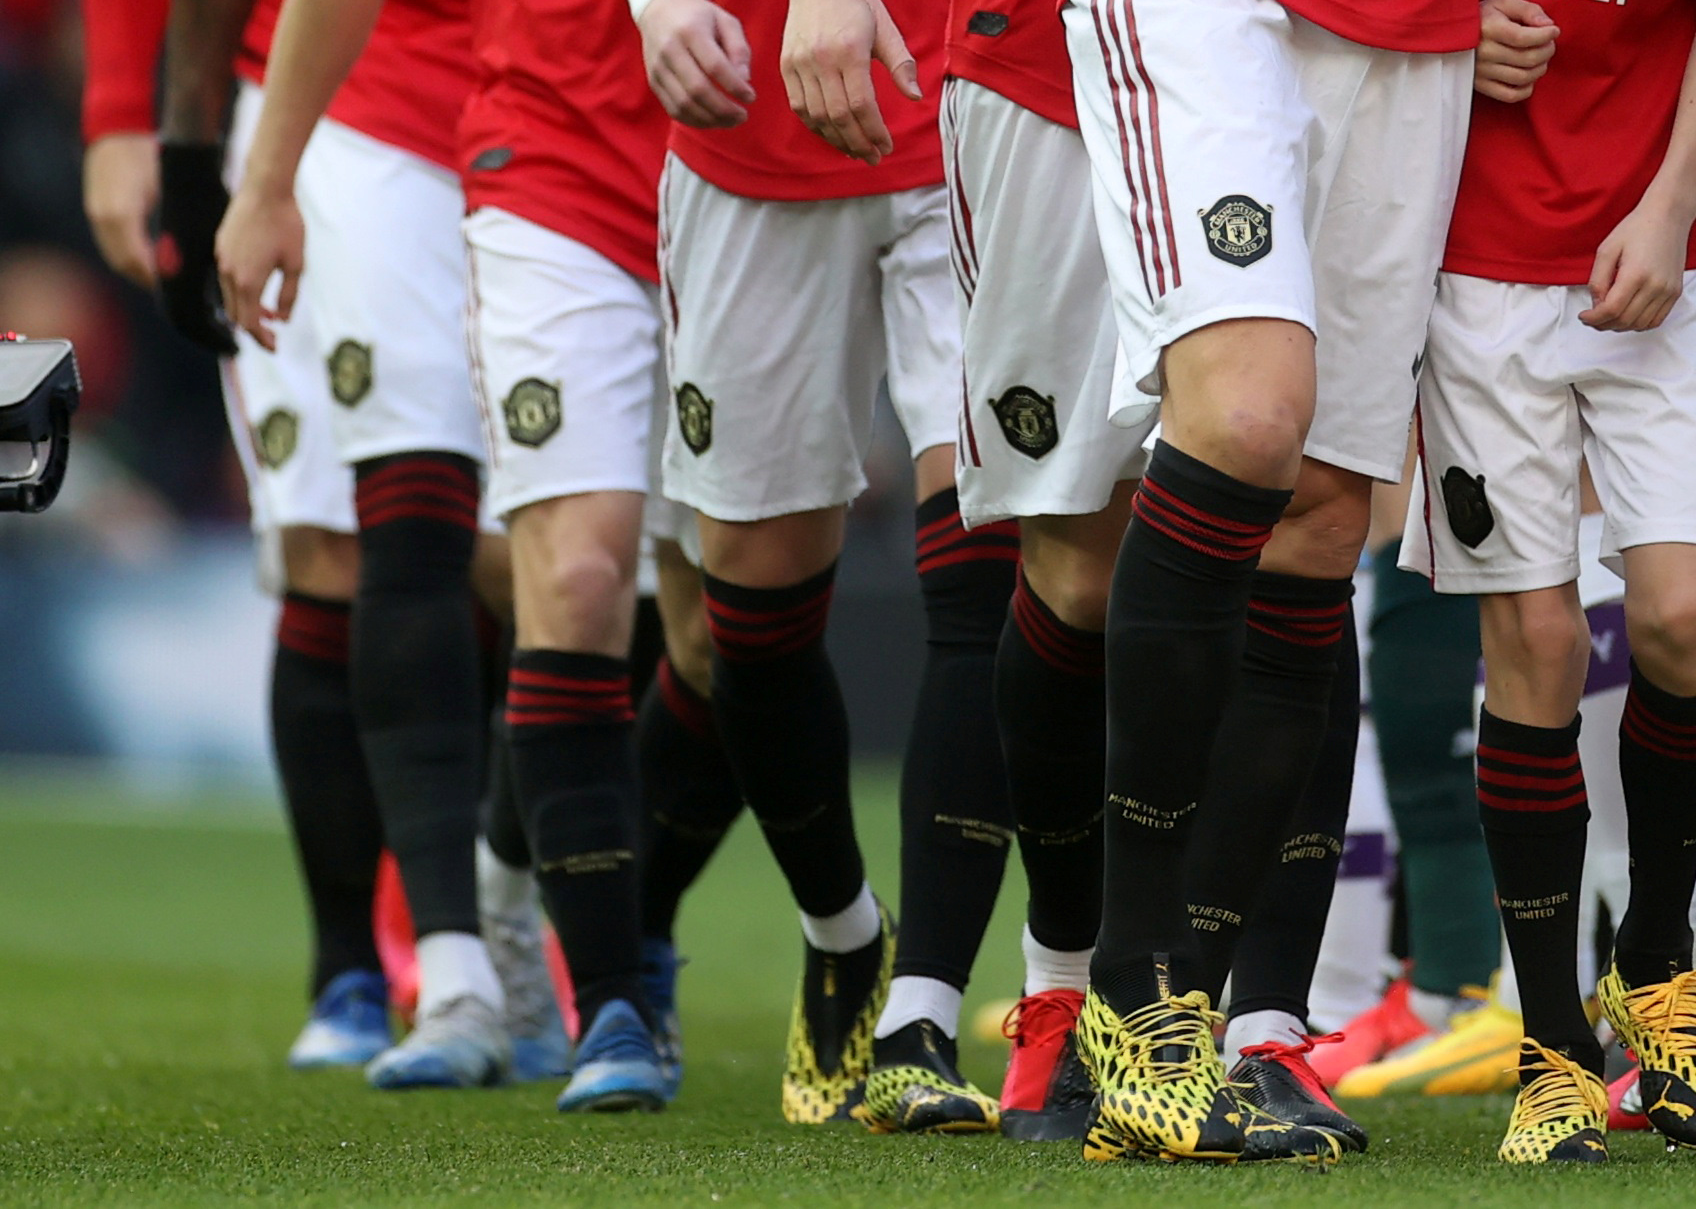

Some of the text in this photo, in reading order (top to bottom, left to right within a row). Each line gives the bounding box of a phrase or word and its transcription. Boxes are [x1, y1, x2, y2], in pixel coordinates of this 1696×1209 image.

[1122, 809, 1174, 829] UNITED
[1281, 847, 1326, 864] UNITED
[1500, 892, 1569, 910] MANCHESTER
[1515, 907, 1555, 920] UNITED
